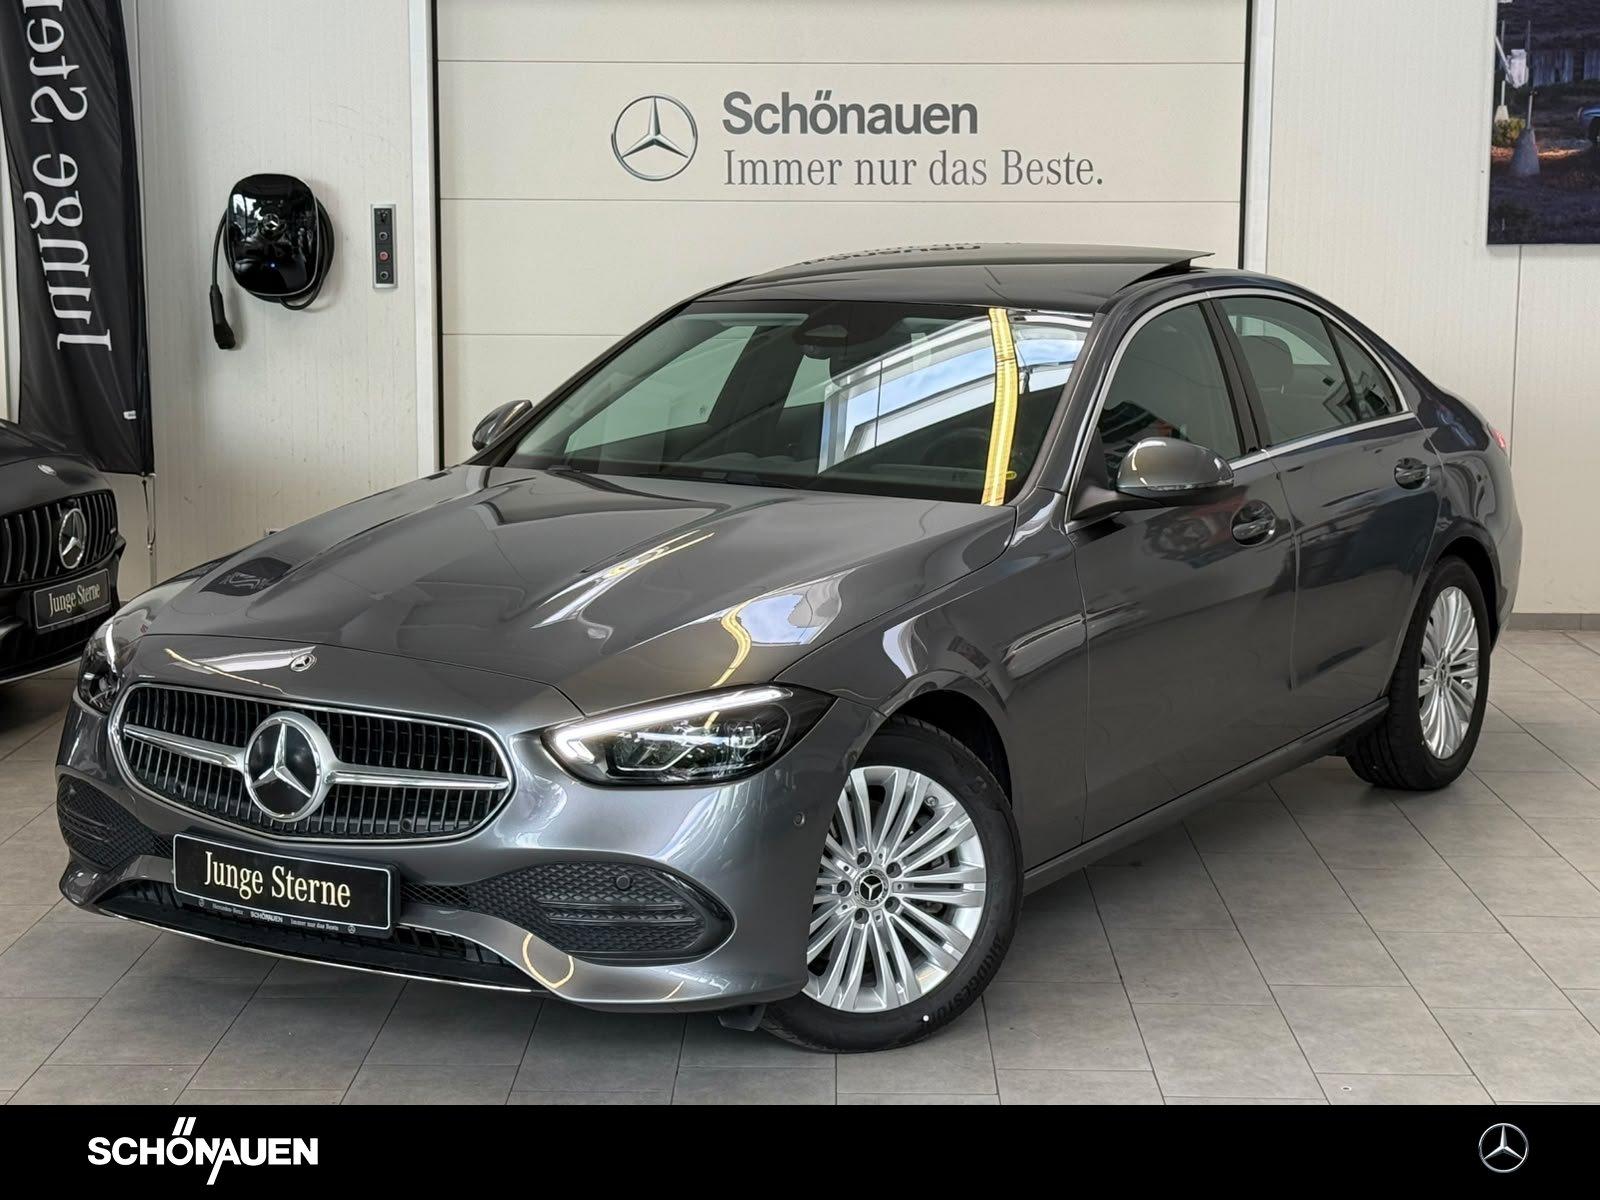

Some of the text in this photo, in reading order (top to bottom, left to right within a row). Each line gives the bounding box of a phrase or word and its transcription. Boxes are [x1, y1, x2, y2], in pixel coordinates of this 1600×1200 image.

[722, 89, 978, 136] Schönauen
[723, 149, 1104, 186] Immer nur das Beste.
[48, 584, 101, 618] Junge Sterne
[204, 851, 351, 908] Junge Sterne
